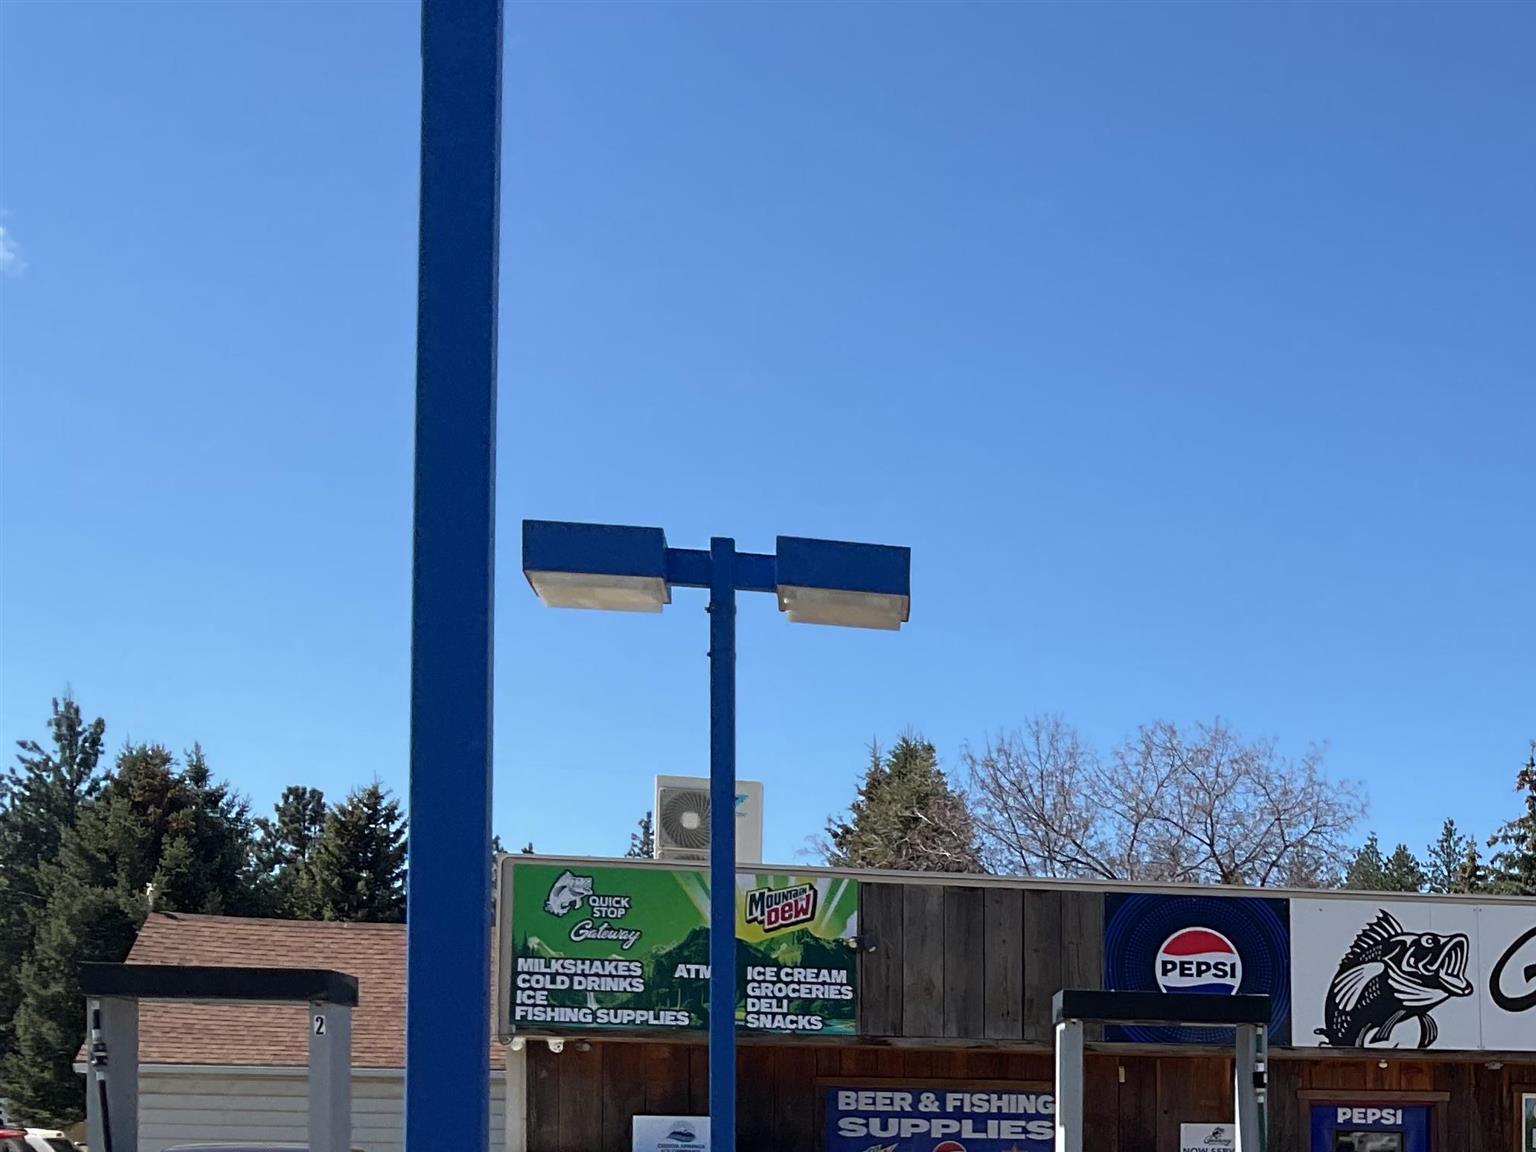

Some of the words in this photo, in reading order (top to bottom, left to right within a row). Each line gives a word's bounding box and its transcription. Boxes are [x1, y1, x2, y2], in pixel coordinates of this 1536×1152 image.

[589, 896, 630, 908] QUICK
[593, 908, 626, 918] STOP
[571, 920, 640, 949] Gateway
[517, 958, 643, 977] MILKSHAKES
[674, 963, 711, 979] ATM
[747, 966, 775, 981] ICE
[776, 967, 847, 984] CREAM
[1161, 960, 1237, 979] PEPSI
[517, 974, 569, 990] COLD
[572, 976, 645, 993] DRINKS
[746, 982, 853, 1000] GROCERIES
[516, 990, 548, 1005] ICE
[747, 998, 788, 1013] DELI
[515, 1006, 593, 1024] FISHING
[596, 1008, 690, 1026] SUPPLIES
[745, 1013, 823, 1030] SNACKS
[315, 1016, 325, 1035] 2
[838, 1091, 912, 1112] BEER
[918, 1092, 940, 1112] &
[946, 1093, 1055, 1114] FISHING
[1337, 1107, 1402, 1125] PEPSI
[838, 1117, 1055, 1140] SUPPLIES
